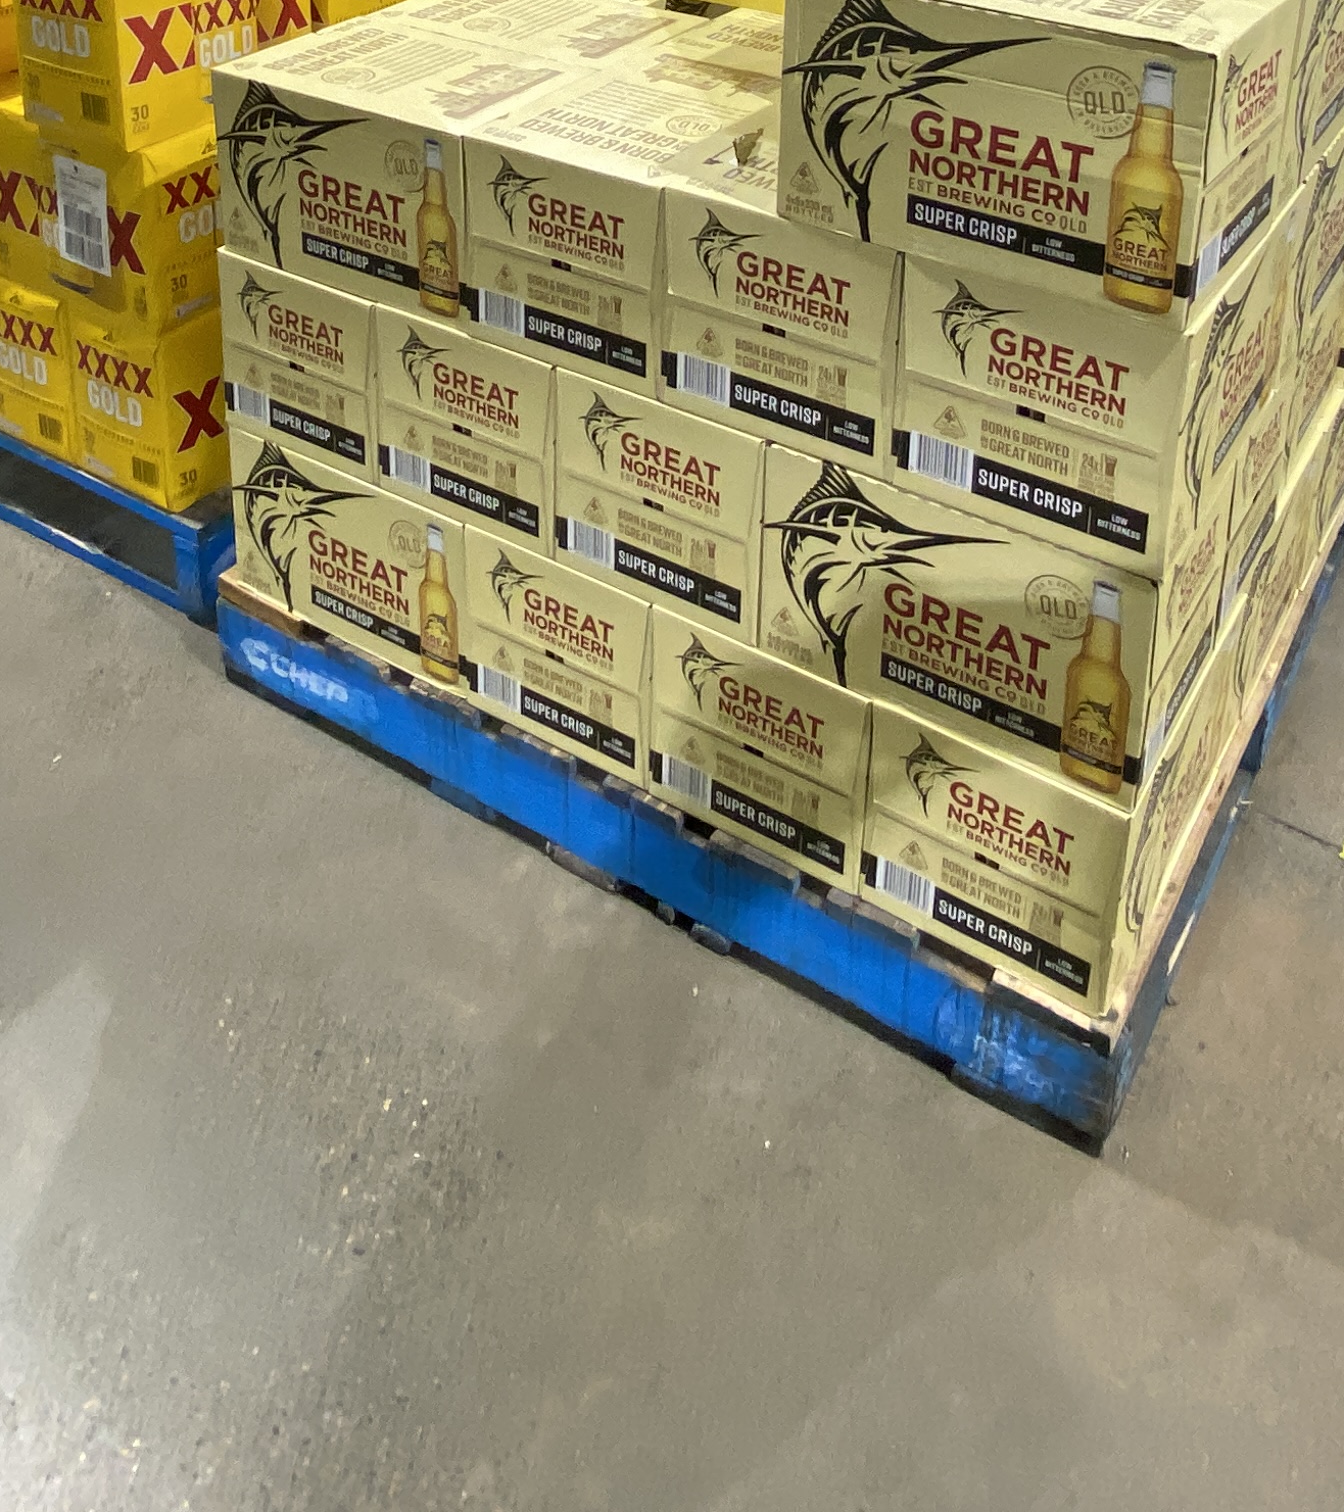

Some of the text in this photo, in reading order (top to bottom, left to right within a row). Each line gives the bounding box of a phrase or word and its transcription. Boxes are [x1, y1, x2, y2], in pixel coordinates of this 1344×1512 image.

[31, 15, 91, 59] GOLD
[130, 105, 150, 122] 30
[1083, 90, 1126, 115] QLD
[909, 110, 1094, 184] GREAT
[298, 169, 406, 224] GREAT
[907, 177, 931, 196] EST
[937, 182, 1027, 220] BREWING
[1059, 214, 1088, 234] QLD
[908, 150, 1091, 217] NORTHERN
[299, 198, 408, 247] NORTHERN
[528, 193, 625, 240] GREAT
[528, 217, 625, 260] NORTHERN
[914, 202, 1017, 246] SUPER CRISP
[305, 237, 369, 270] SUPER CRISP
[528, 315, 602, 352] SUPER CRISP
[990, 327, 1129, 392] GREAT
[987, 355, 1127, 417] NORTHERN
[977, 468, 1084, 518] SUPER CRISP
[884, 583, 1052, 671] GREAT
[882, 614, 1048, 701] NORTHERN
